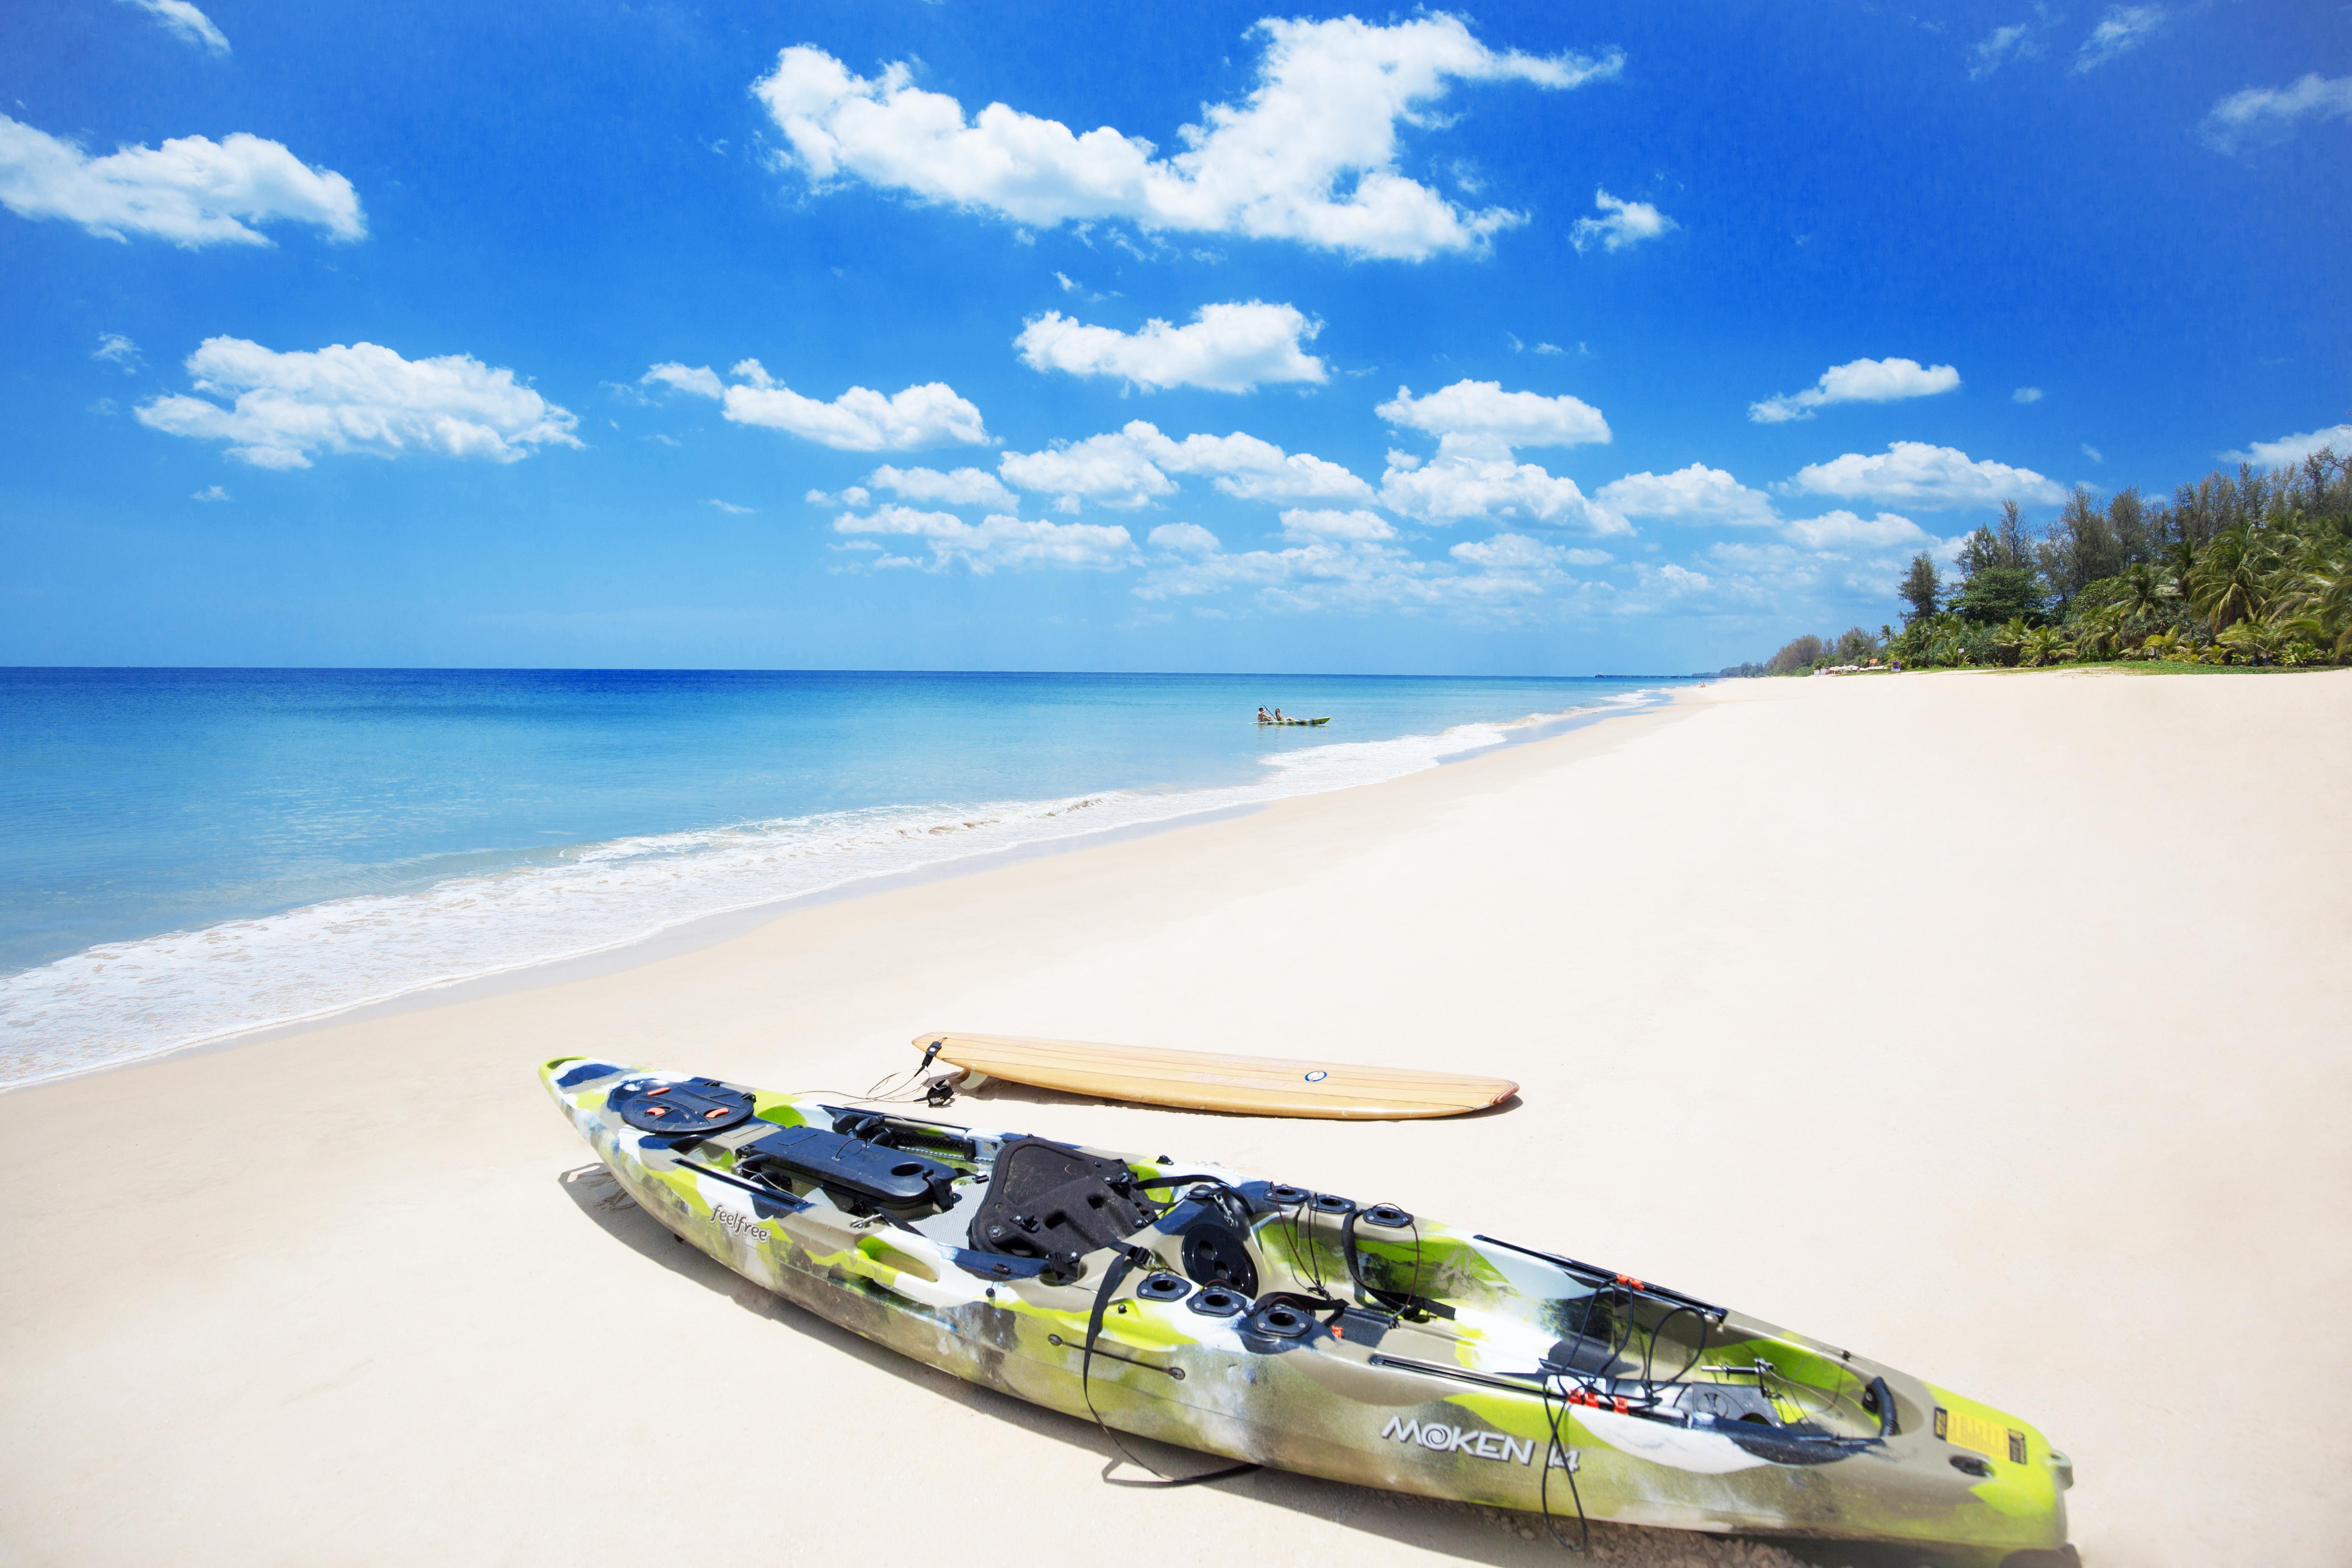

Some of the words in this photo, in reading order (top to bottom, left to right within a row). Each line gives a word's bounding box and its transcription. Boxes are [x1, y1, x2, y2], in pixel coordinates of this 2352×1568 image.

[709, 1204, 768, 1242] feelfree
[1381, 1415, 1534, 1465] MOKEN
[1548, 1446, 1579, 1473] 14
